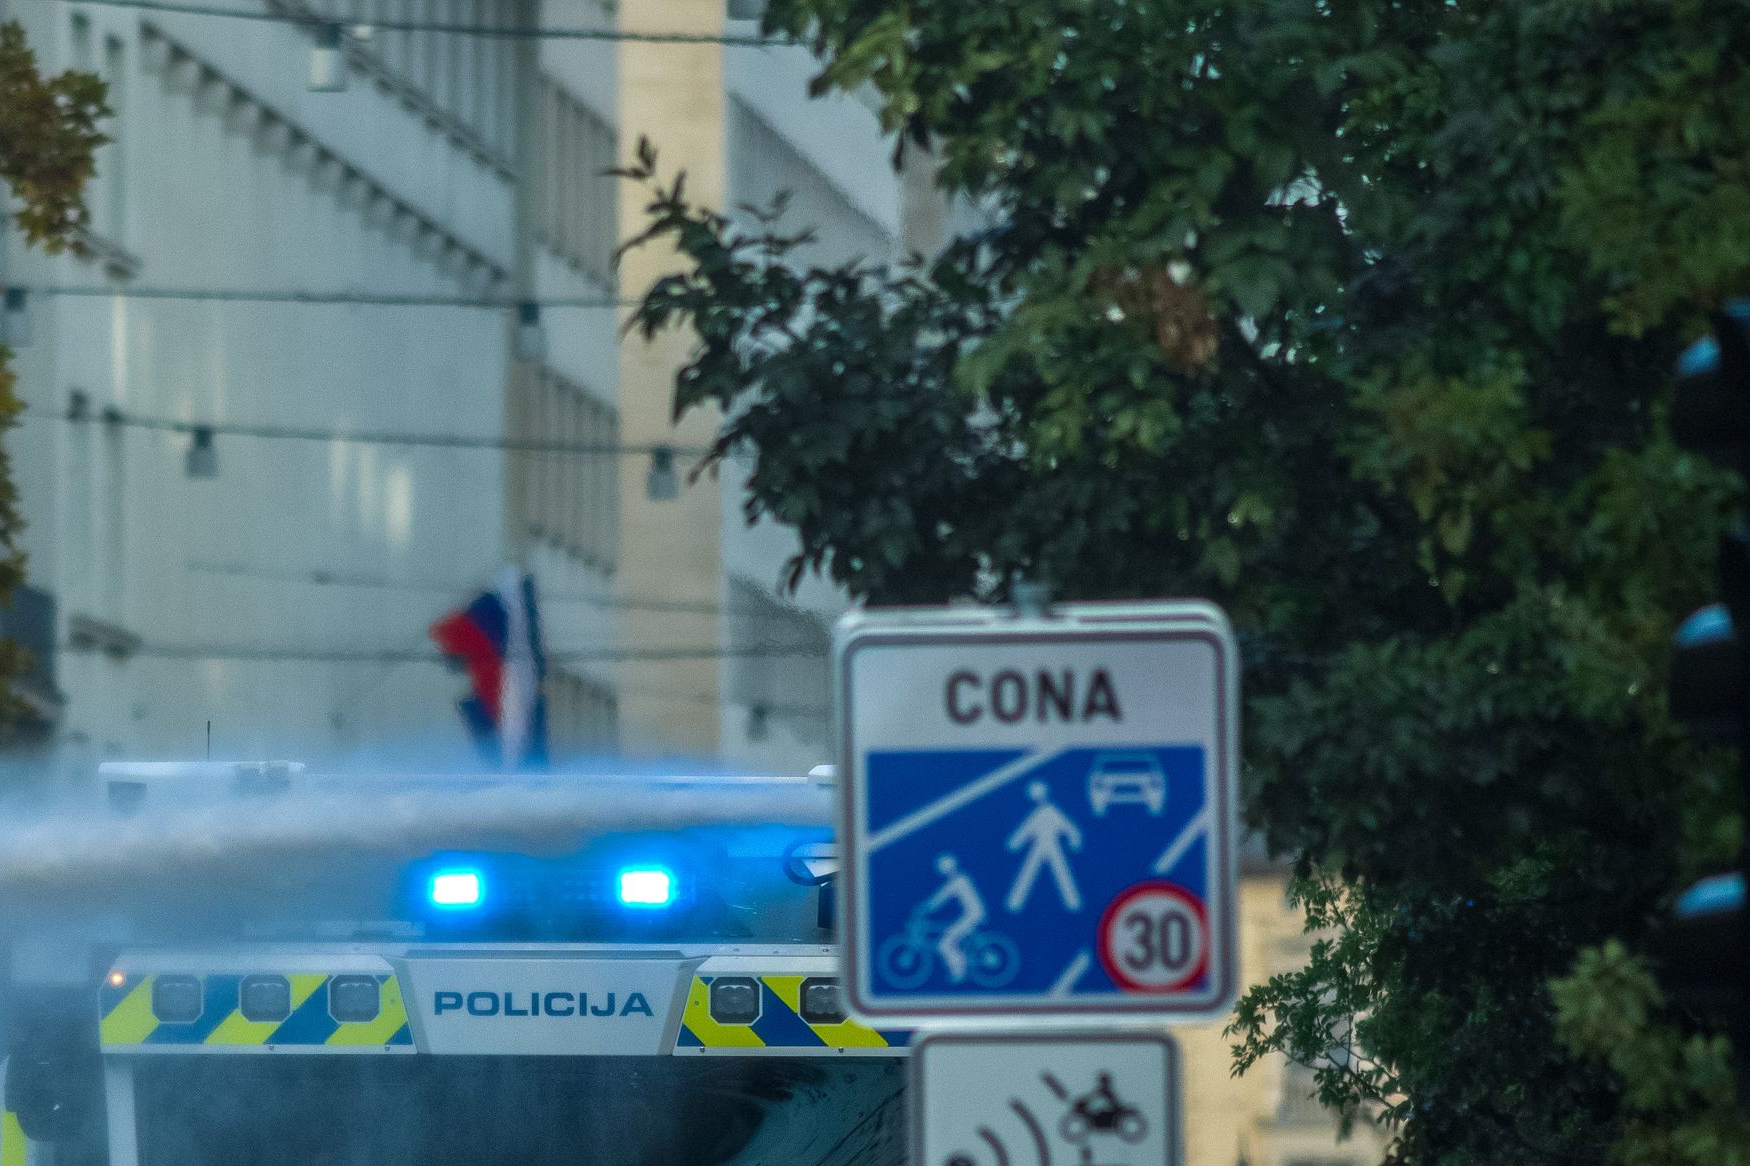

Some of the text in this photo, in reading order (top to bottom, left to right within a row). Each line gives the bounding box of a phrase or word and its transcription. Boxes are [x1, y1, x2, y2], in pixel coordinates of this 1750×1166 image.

[945, 668, 1123, 725] CONA
[1124, 910, 1191, 973] 30
[434, 991, 655, 1017] POLICIJA
